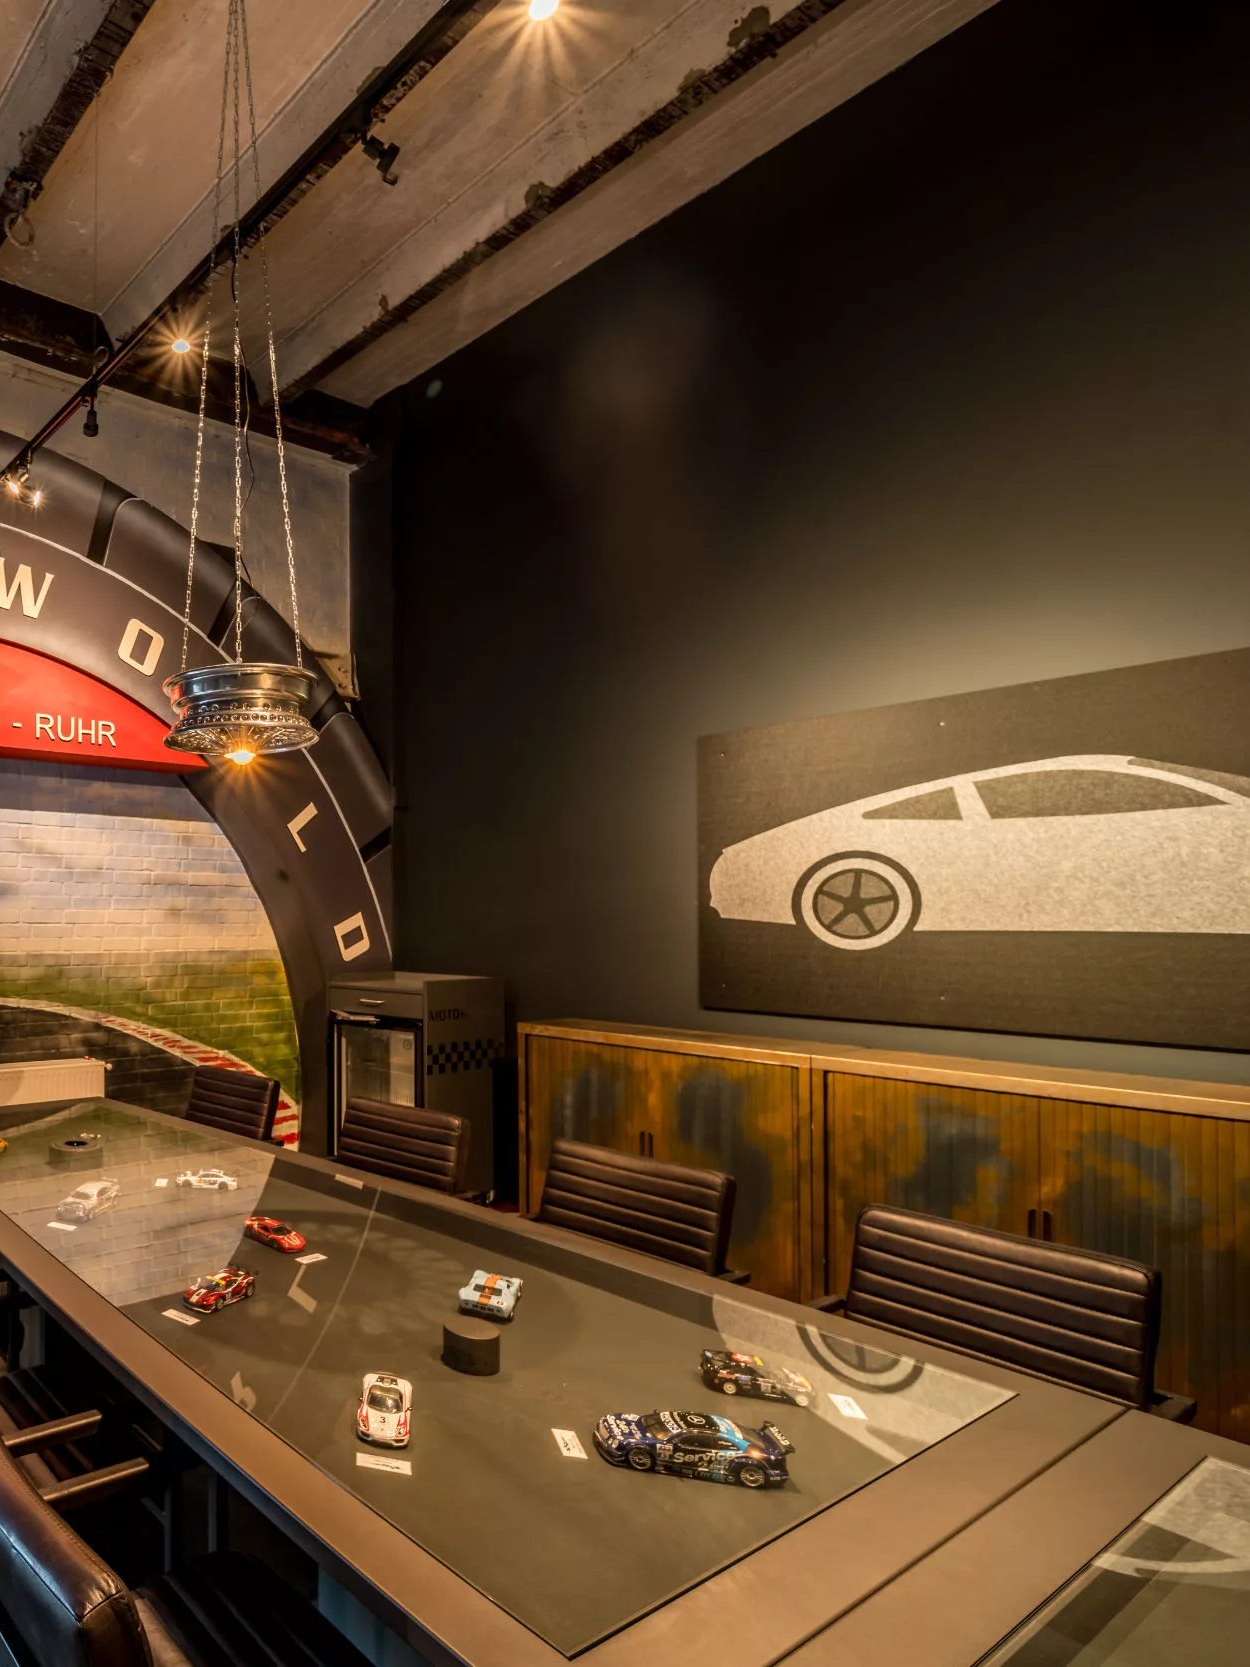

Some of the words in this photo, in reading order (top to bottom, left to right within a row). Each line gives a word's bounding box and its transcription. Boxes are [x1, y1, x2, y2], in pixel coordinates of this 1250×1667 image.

[12, 721, 23, 729] -
[34, 713, 117, 747] RUHR
[673, 1450, 736, 1463] Service
